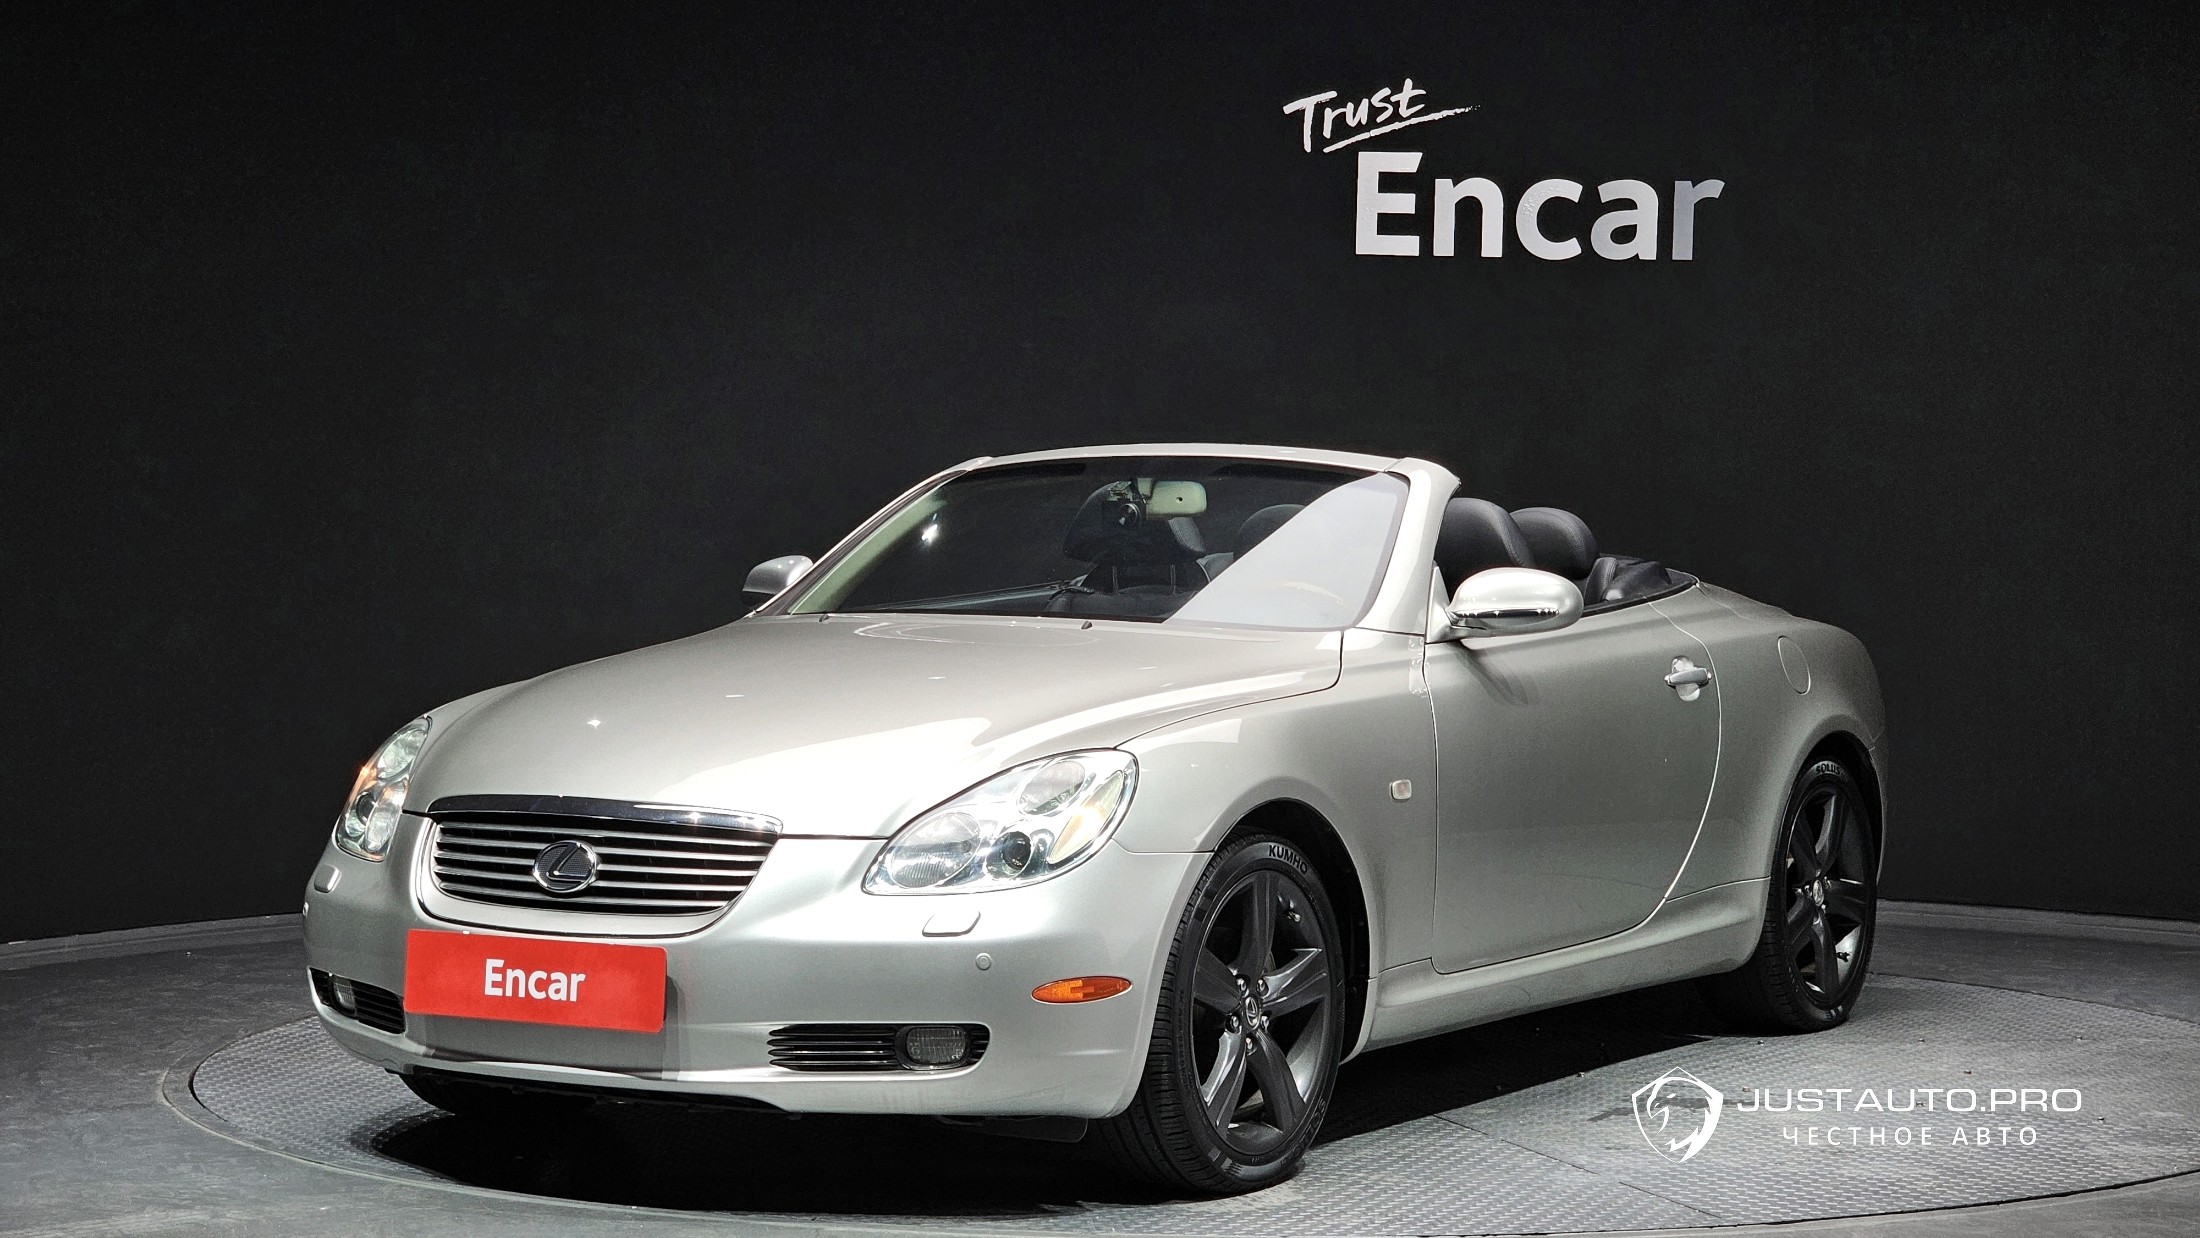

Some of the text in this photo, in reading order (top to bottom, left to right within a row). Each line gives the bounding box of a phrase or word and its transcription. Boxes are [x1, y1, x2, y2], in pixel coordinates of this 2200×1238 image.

[1283, 78, 1427, 153] Trust
[1355, 151, 1726, 261] Encar
[1268, 844, 1309, 875] KUMHO
[484, 958, 586, 1002] Encar
